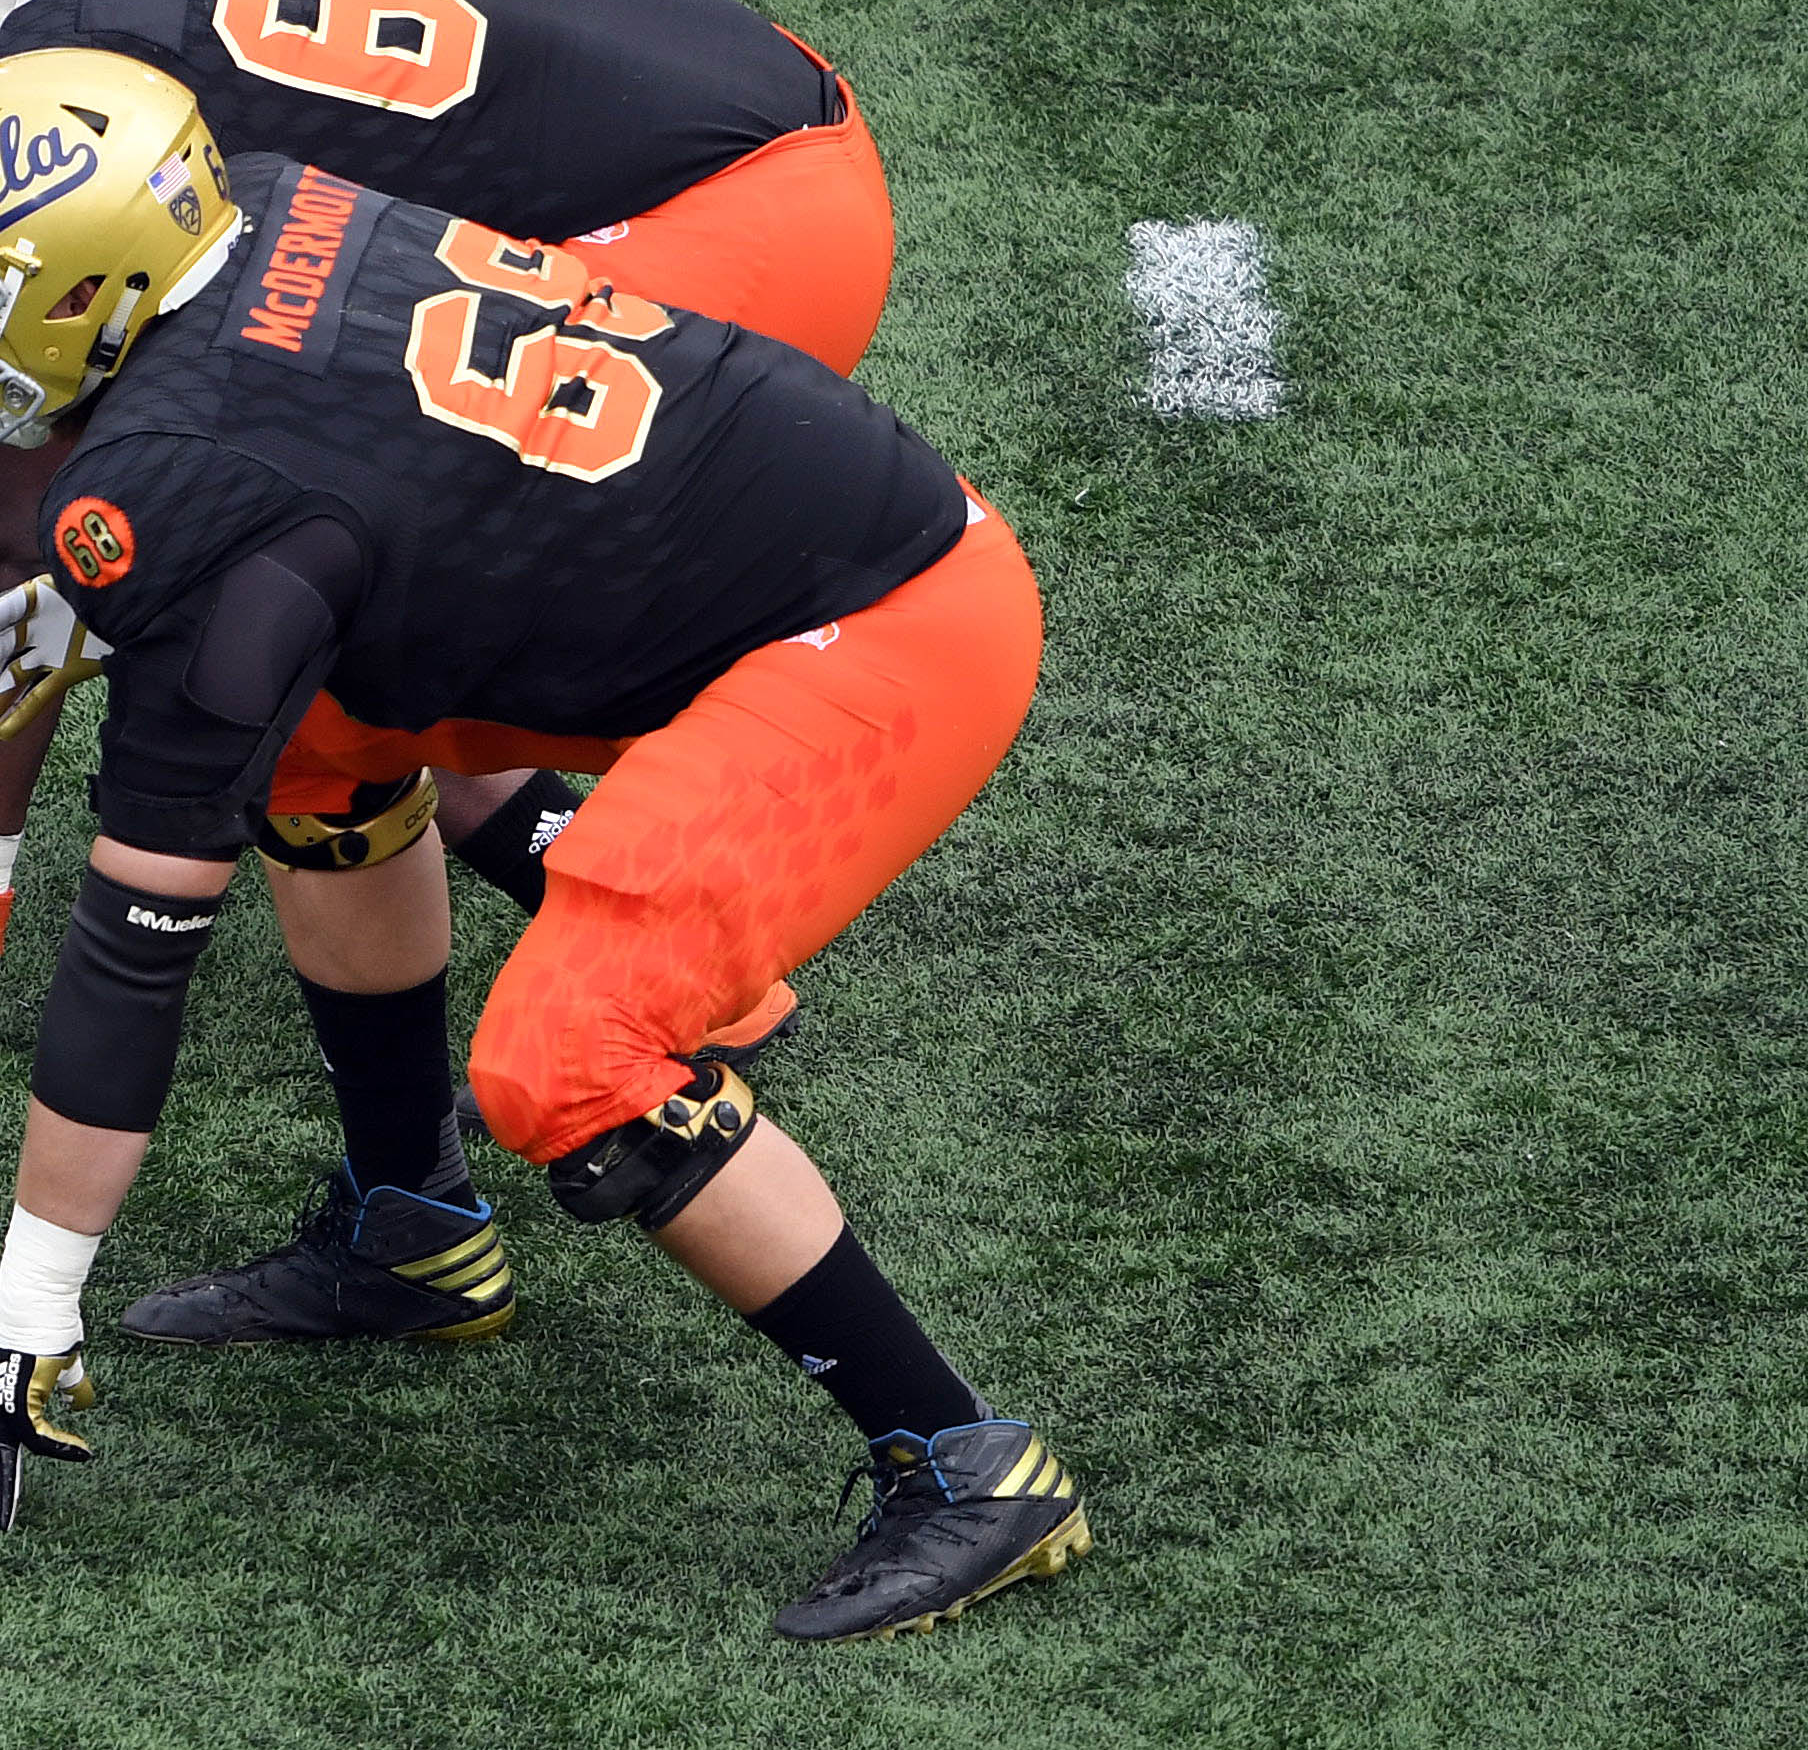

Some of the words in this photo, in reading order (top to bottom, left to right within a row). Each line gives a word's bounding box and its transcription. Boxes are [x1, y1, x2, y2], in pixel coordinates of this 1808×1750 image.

[404, 218, 675, 484] 68
[62, 509, 124, 580] 68
[4, 1352, 22, 1414] adidas
